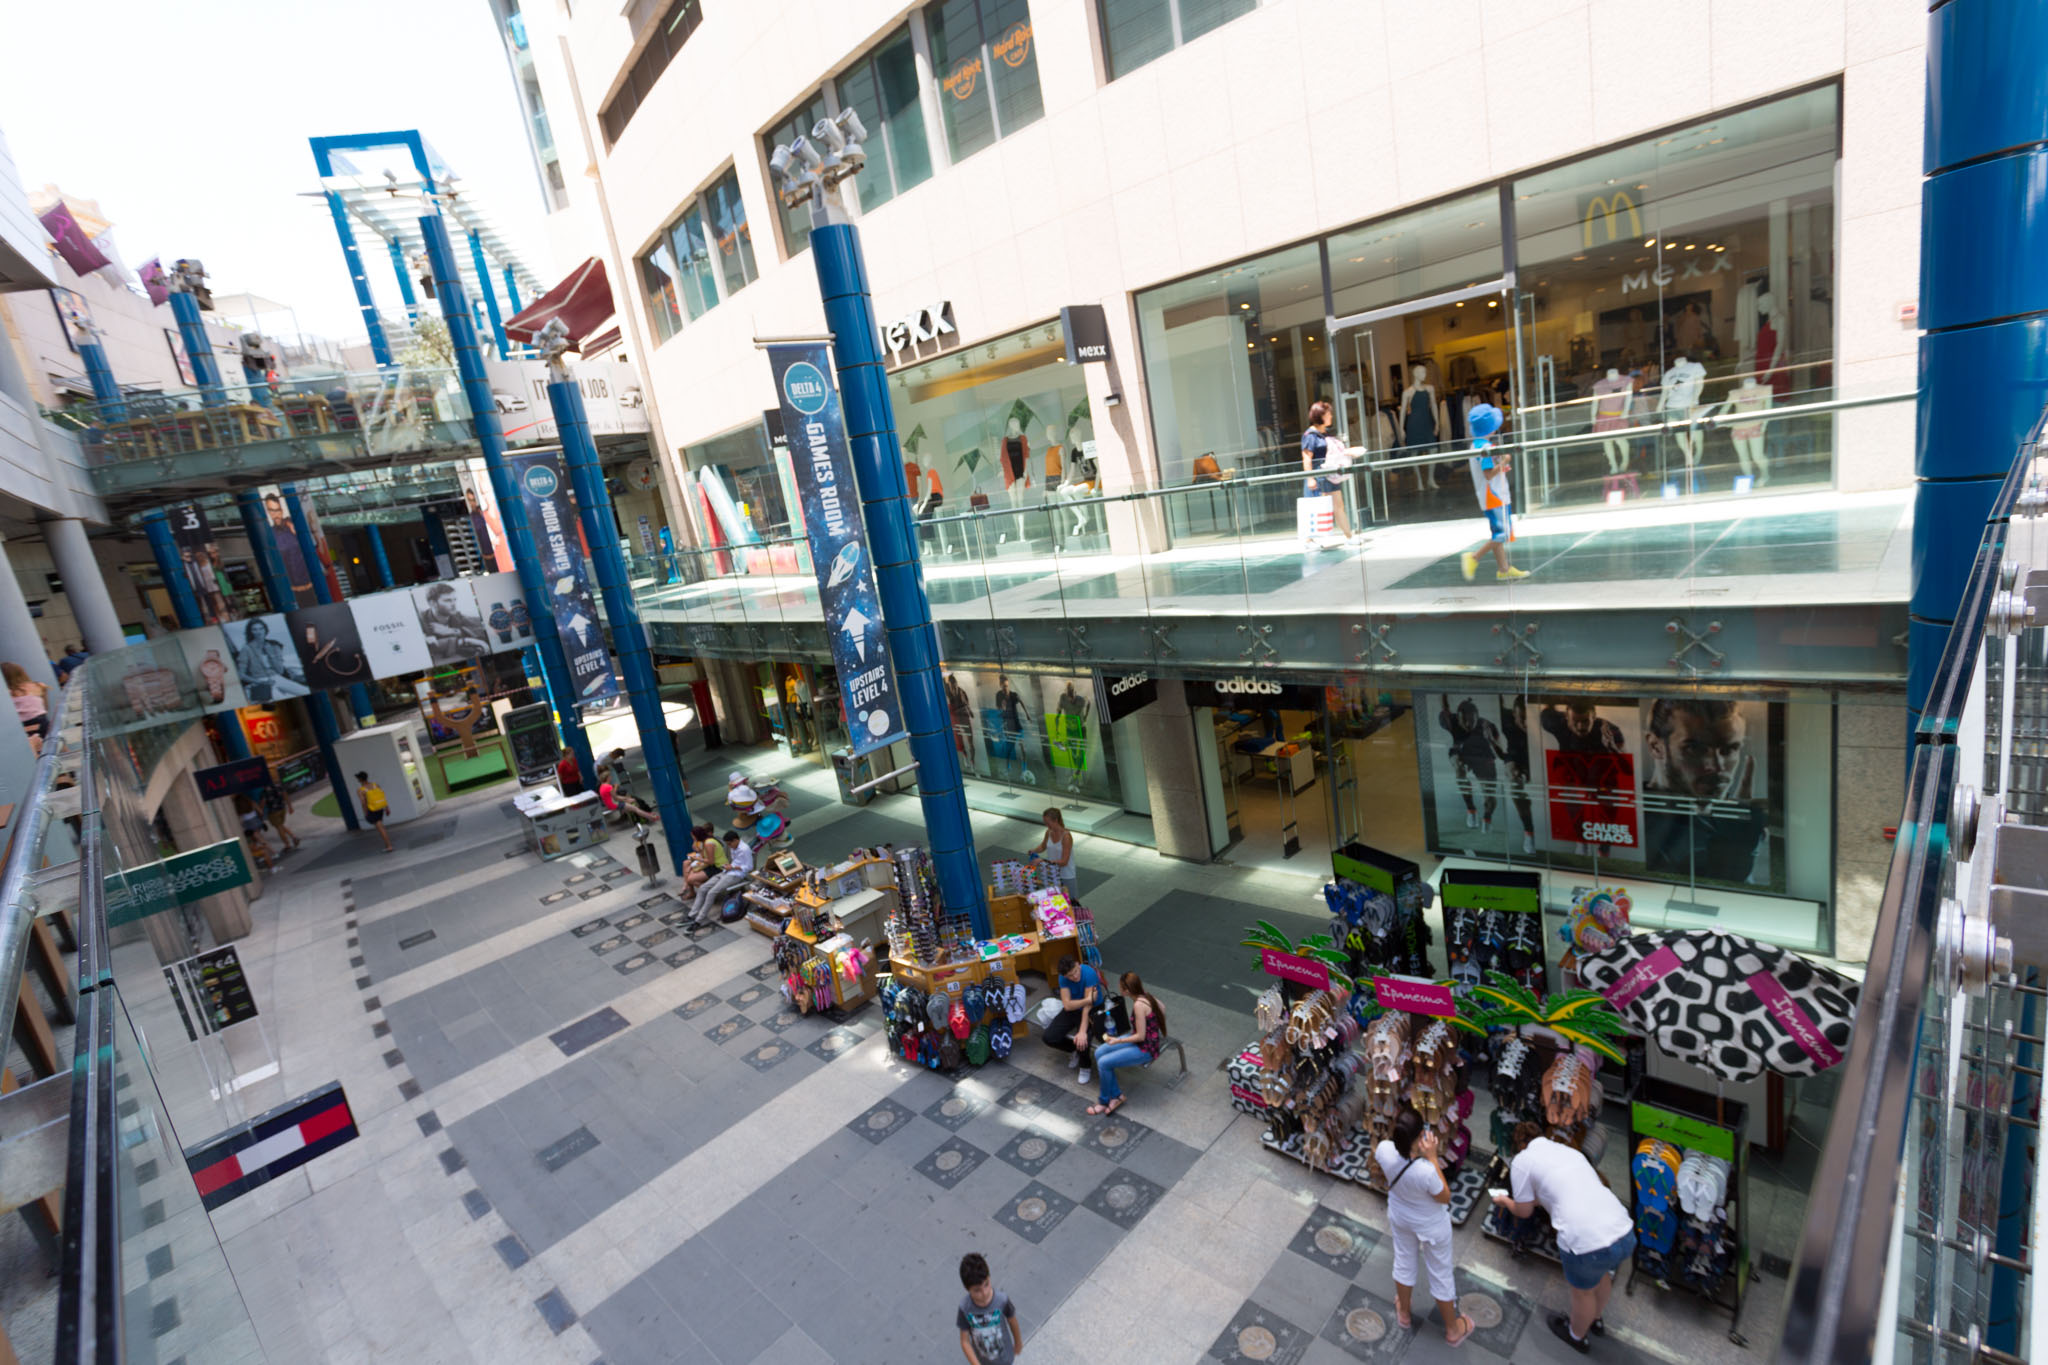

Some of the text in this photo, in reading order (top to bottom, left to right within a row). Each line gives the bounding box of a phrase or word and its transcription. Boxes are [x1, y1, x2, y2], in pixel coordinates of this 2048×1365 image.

[589, 379, 609, 399] JOB
[791, 382, 815, 395] DELTA
[806, 421, 835, 484] GAMES
[819, 484, 846, 538] ROOM
[539, 500, 571, 571] GAMES ROOM
[373, 621, 404, 632] FOSSIL
[574, 649, 604, 666] UPSTAIRS
[576, 655, 606, 677] LEVEL 4
[849, 664, 886, 693] UPSTAIRS
[1111, 670, 1149, 696] adidas
[1215, 675, 1283, 695] adidas
[852, 678, 889, 709] LEVEL 4
[1582, 821, 1630, 835] CAUSE
[1582, 831, 1634, 844] CHAOS
[175, 863, 239, 893] SPENCER
[1266, 954, 1325, 981] Ipanema
[1380, 983, 1448, 1006] Ipanema
[1608, 963, 1659, 1001] Ipanema
[1772, 995, 1834, 1066] Ipanema
